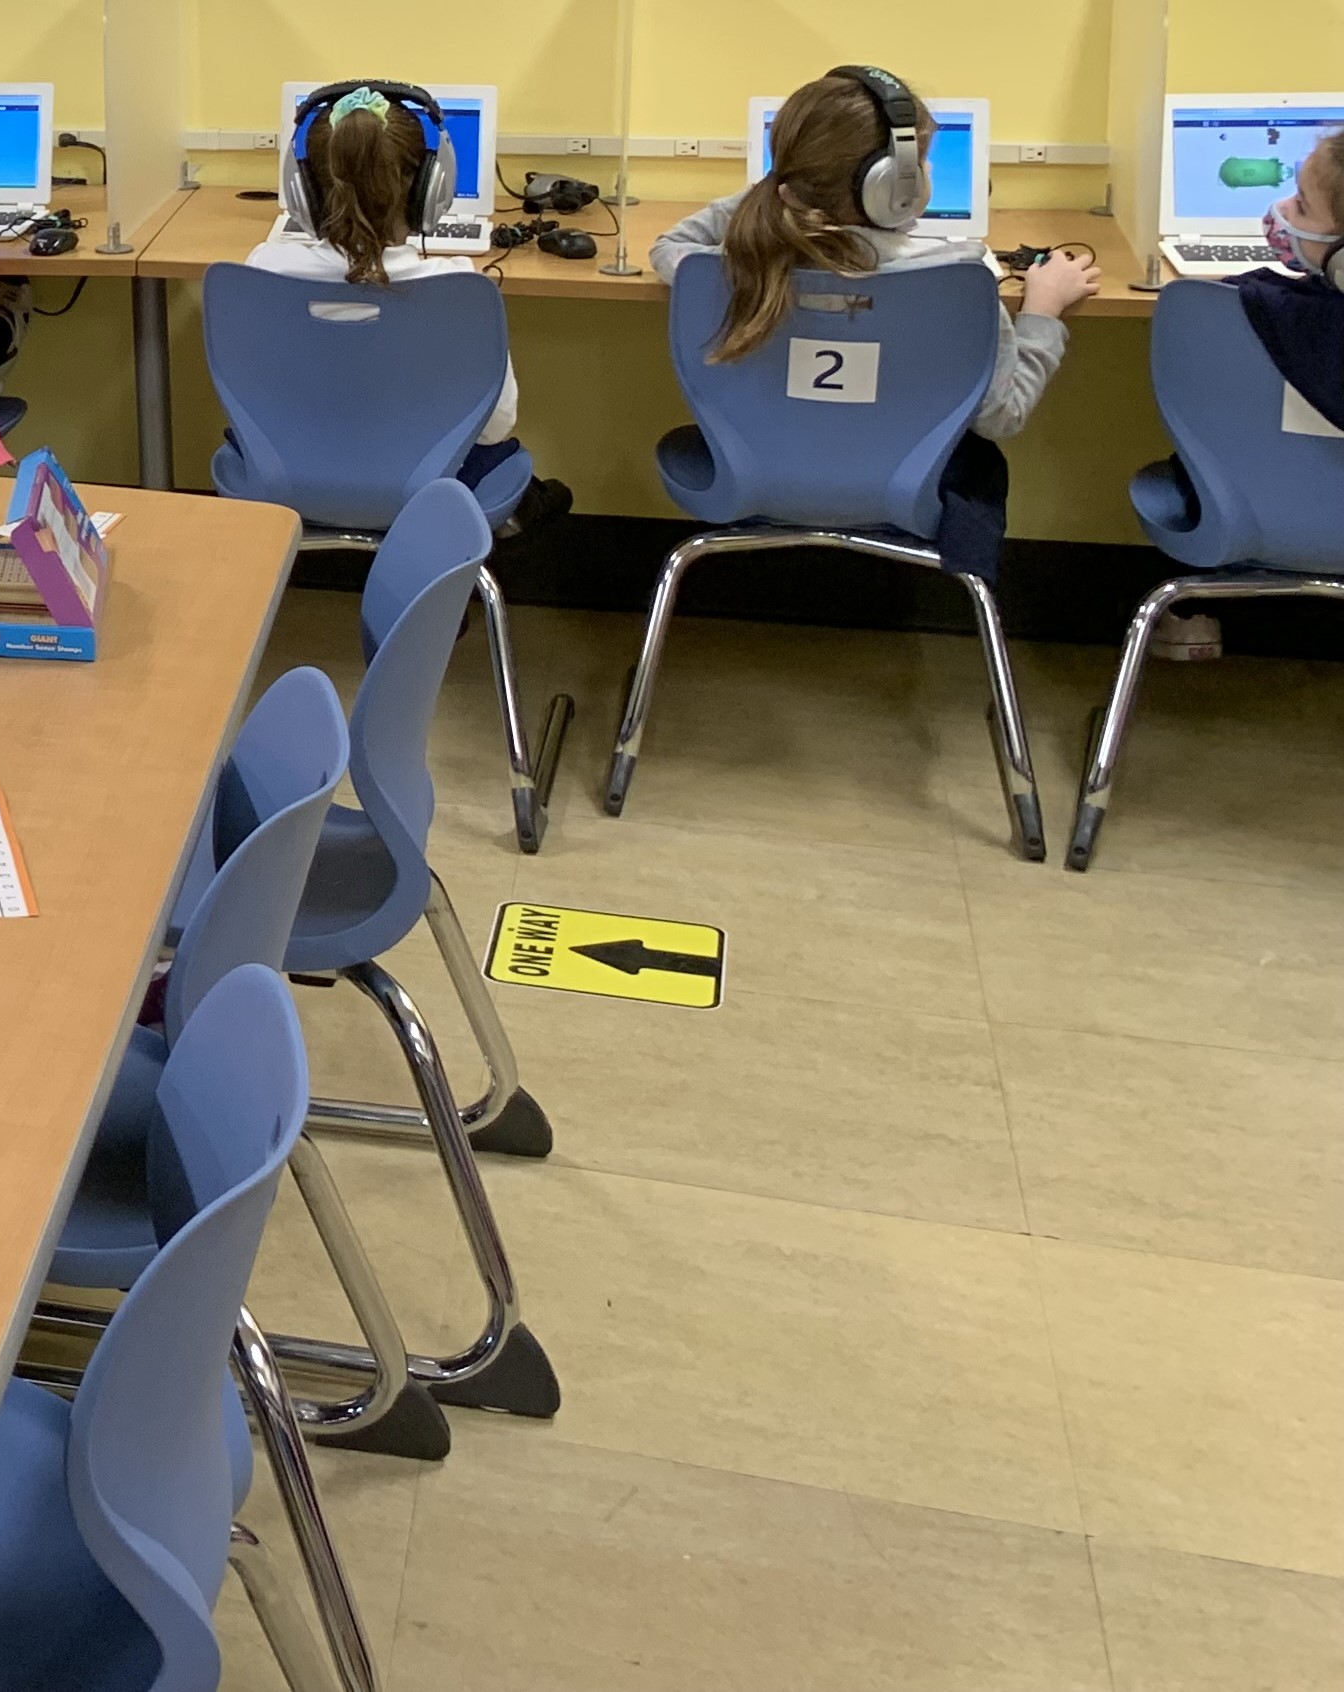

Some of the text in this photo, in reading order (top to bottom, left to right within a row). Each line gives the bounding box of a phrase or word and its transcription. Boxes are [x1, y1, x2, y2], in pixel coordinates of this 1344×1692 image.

[812, 349, 844, 390] 2
[6, 642, 34, 651] Number
[57, 645, 83, 654] Stamps
[30, 634, 59, 644] GIANT
[508, 907, 561, 976] ONE WAY
